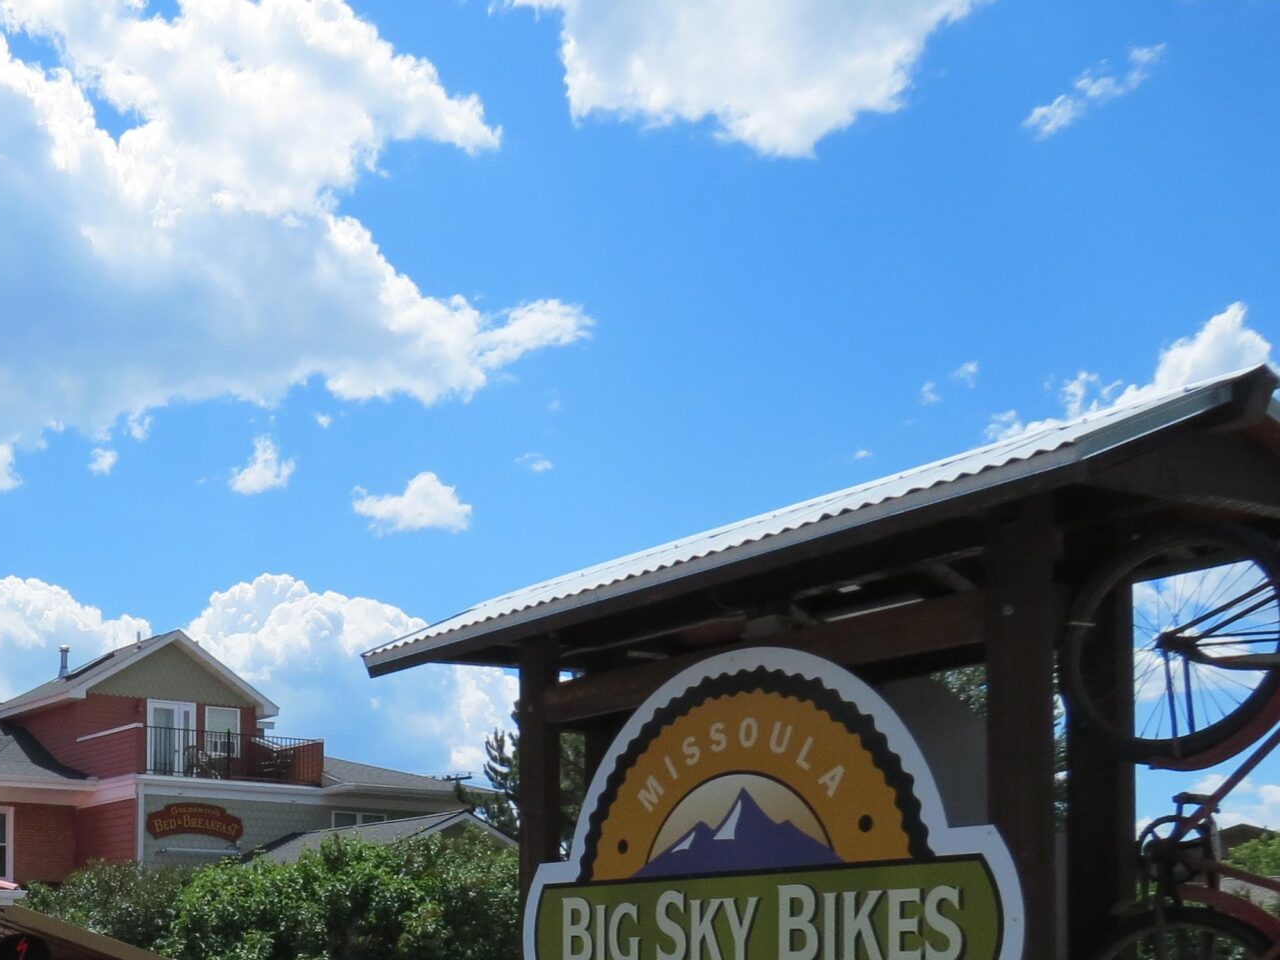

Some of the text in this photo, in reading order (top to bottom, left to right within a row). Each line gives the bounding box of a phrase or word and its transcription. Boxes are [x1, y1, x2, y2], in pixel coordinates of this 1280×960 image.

[637, 716, 847, 813] MISSOULA
[153, 818, 177, 833] BED
[182, 815, 241, 836] BREAKFAST
